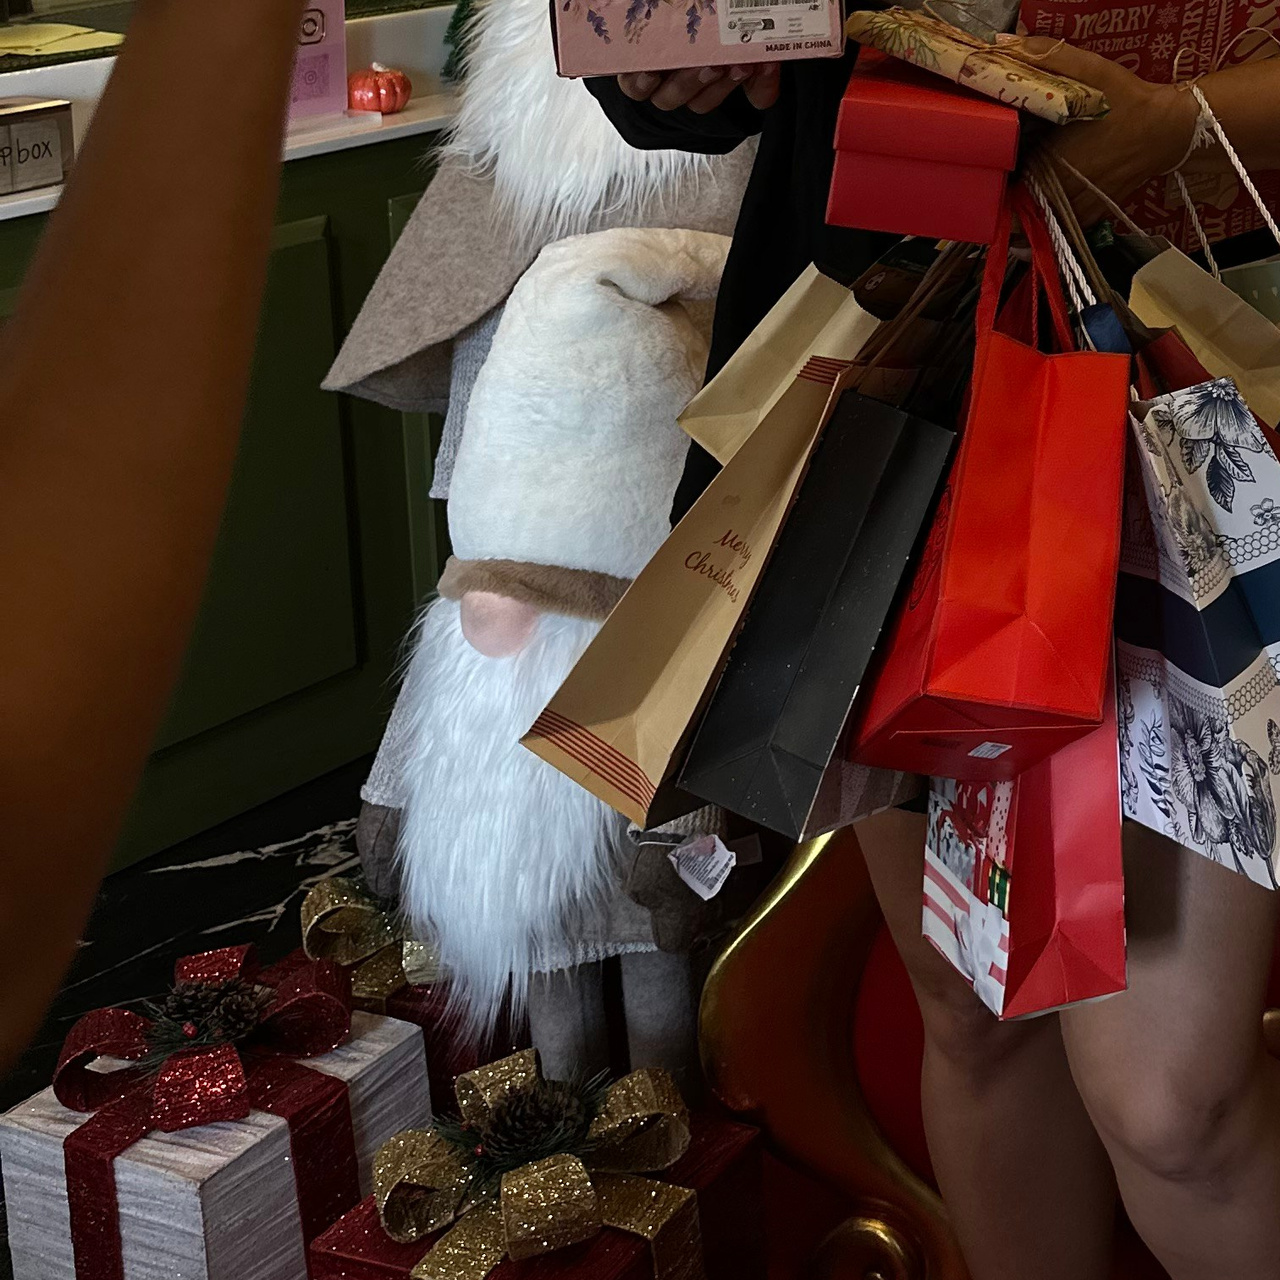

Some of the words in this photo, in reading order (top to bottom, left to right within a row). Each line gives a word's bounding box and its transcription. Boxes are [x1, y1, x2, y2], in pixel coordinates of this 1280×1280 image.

[765, 43, 791, 52] MADE
[793, 41, 802, 50] IN
[805, 40, 832, 50] CHINA
[16, 138, 53, 164] box
